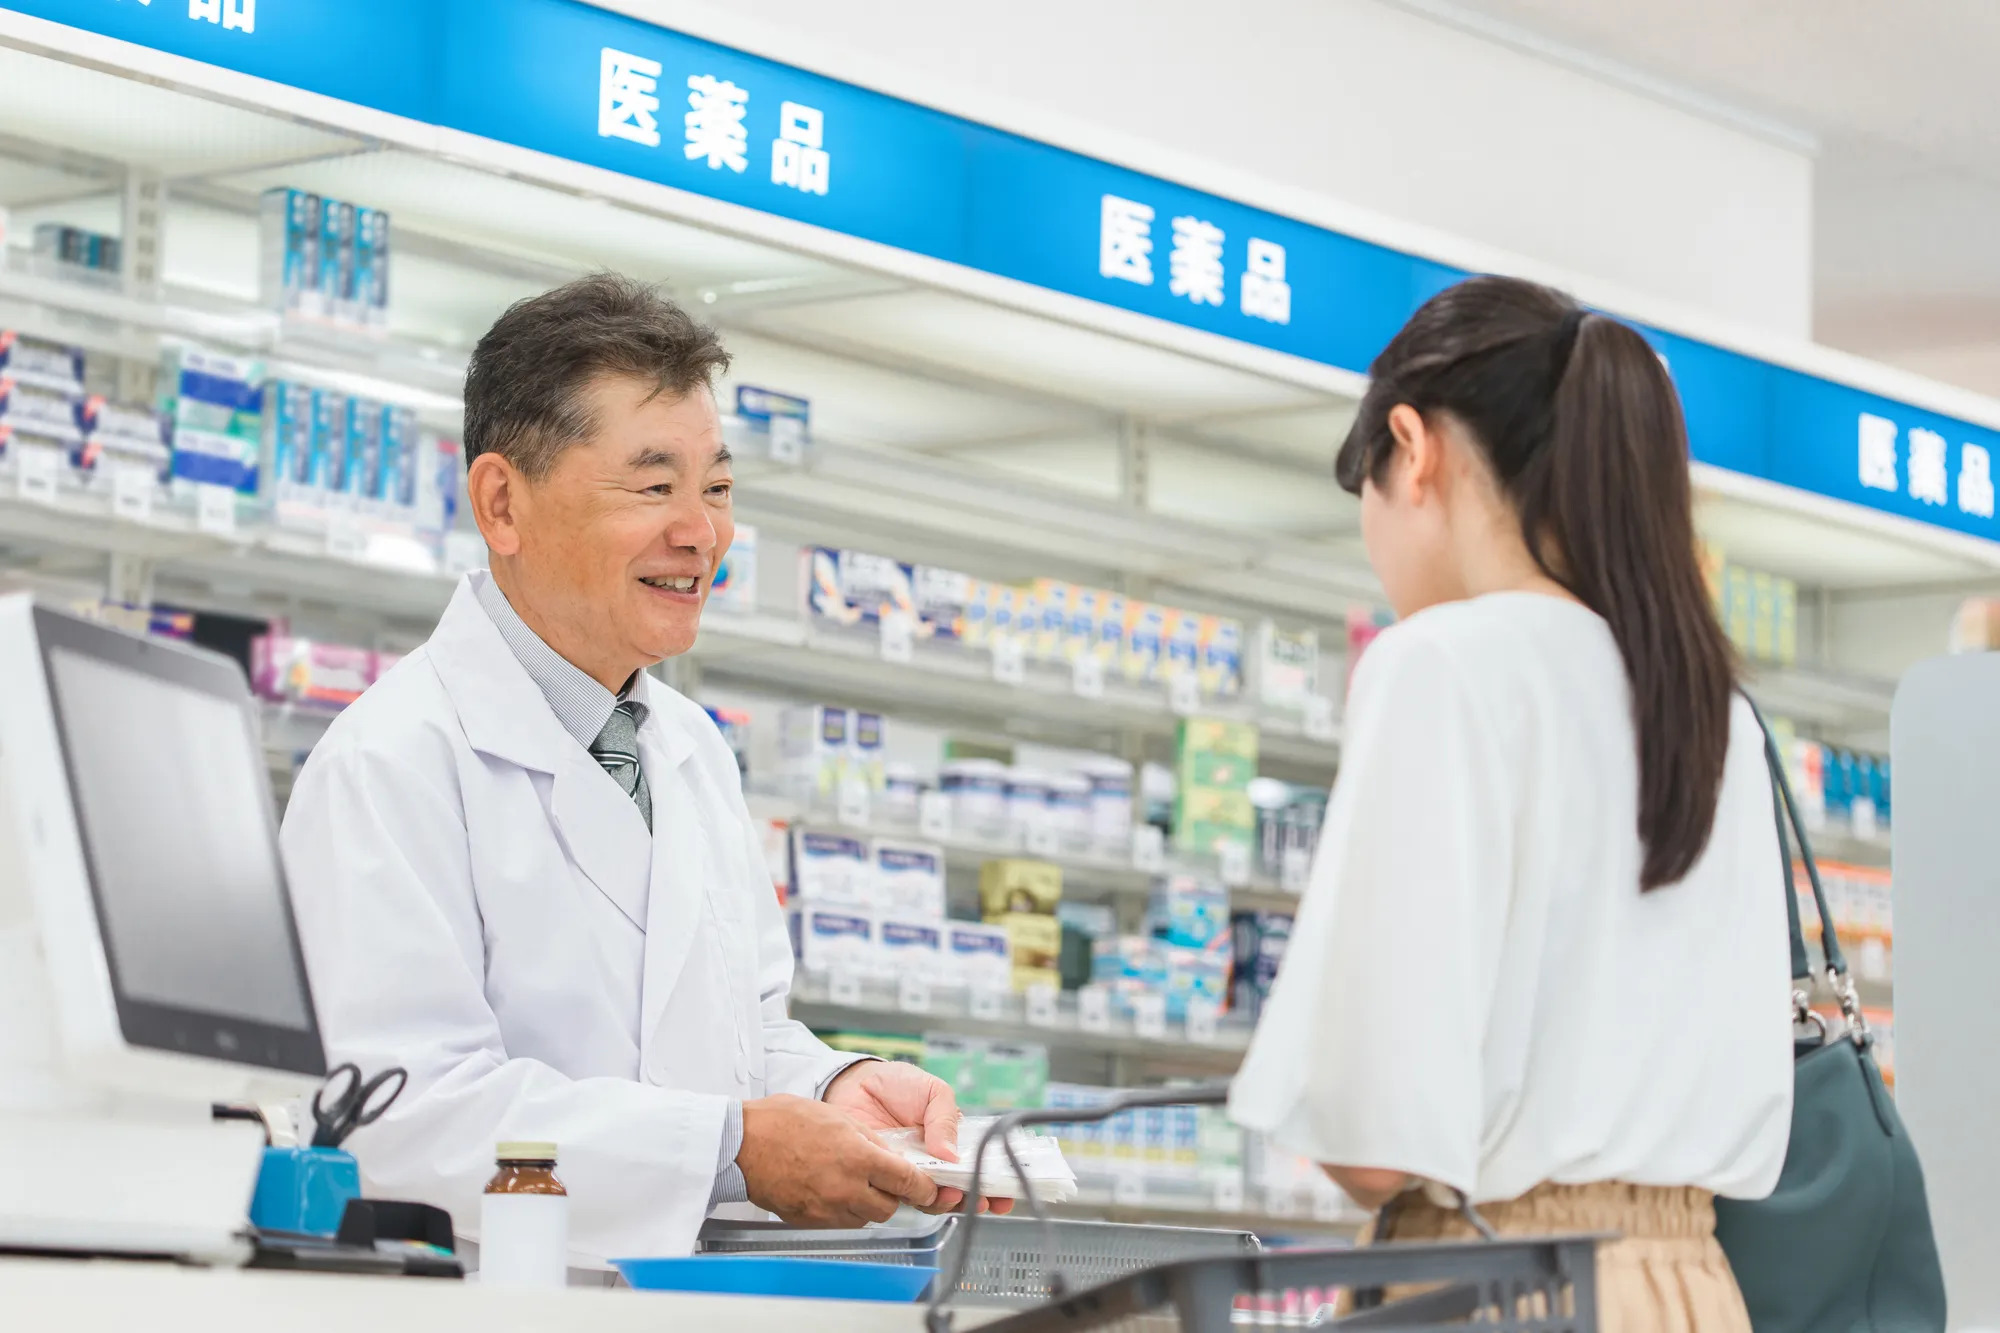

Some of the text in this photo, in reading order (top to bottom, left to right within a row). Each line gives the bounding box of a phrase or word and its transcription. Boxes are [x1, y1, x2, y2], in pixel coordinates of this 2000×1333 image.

[598, 47, 830, 196] 医薬品
[1099, 194, 1291, 325] 医薬品
